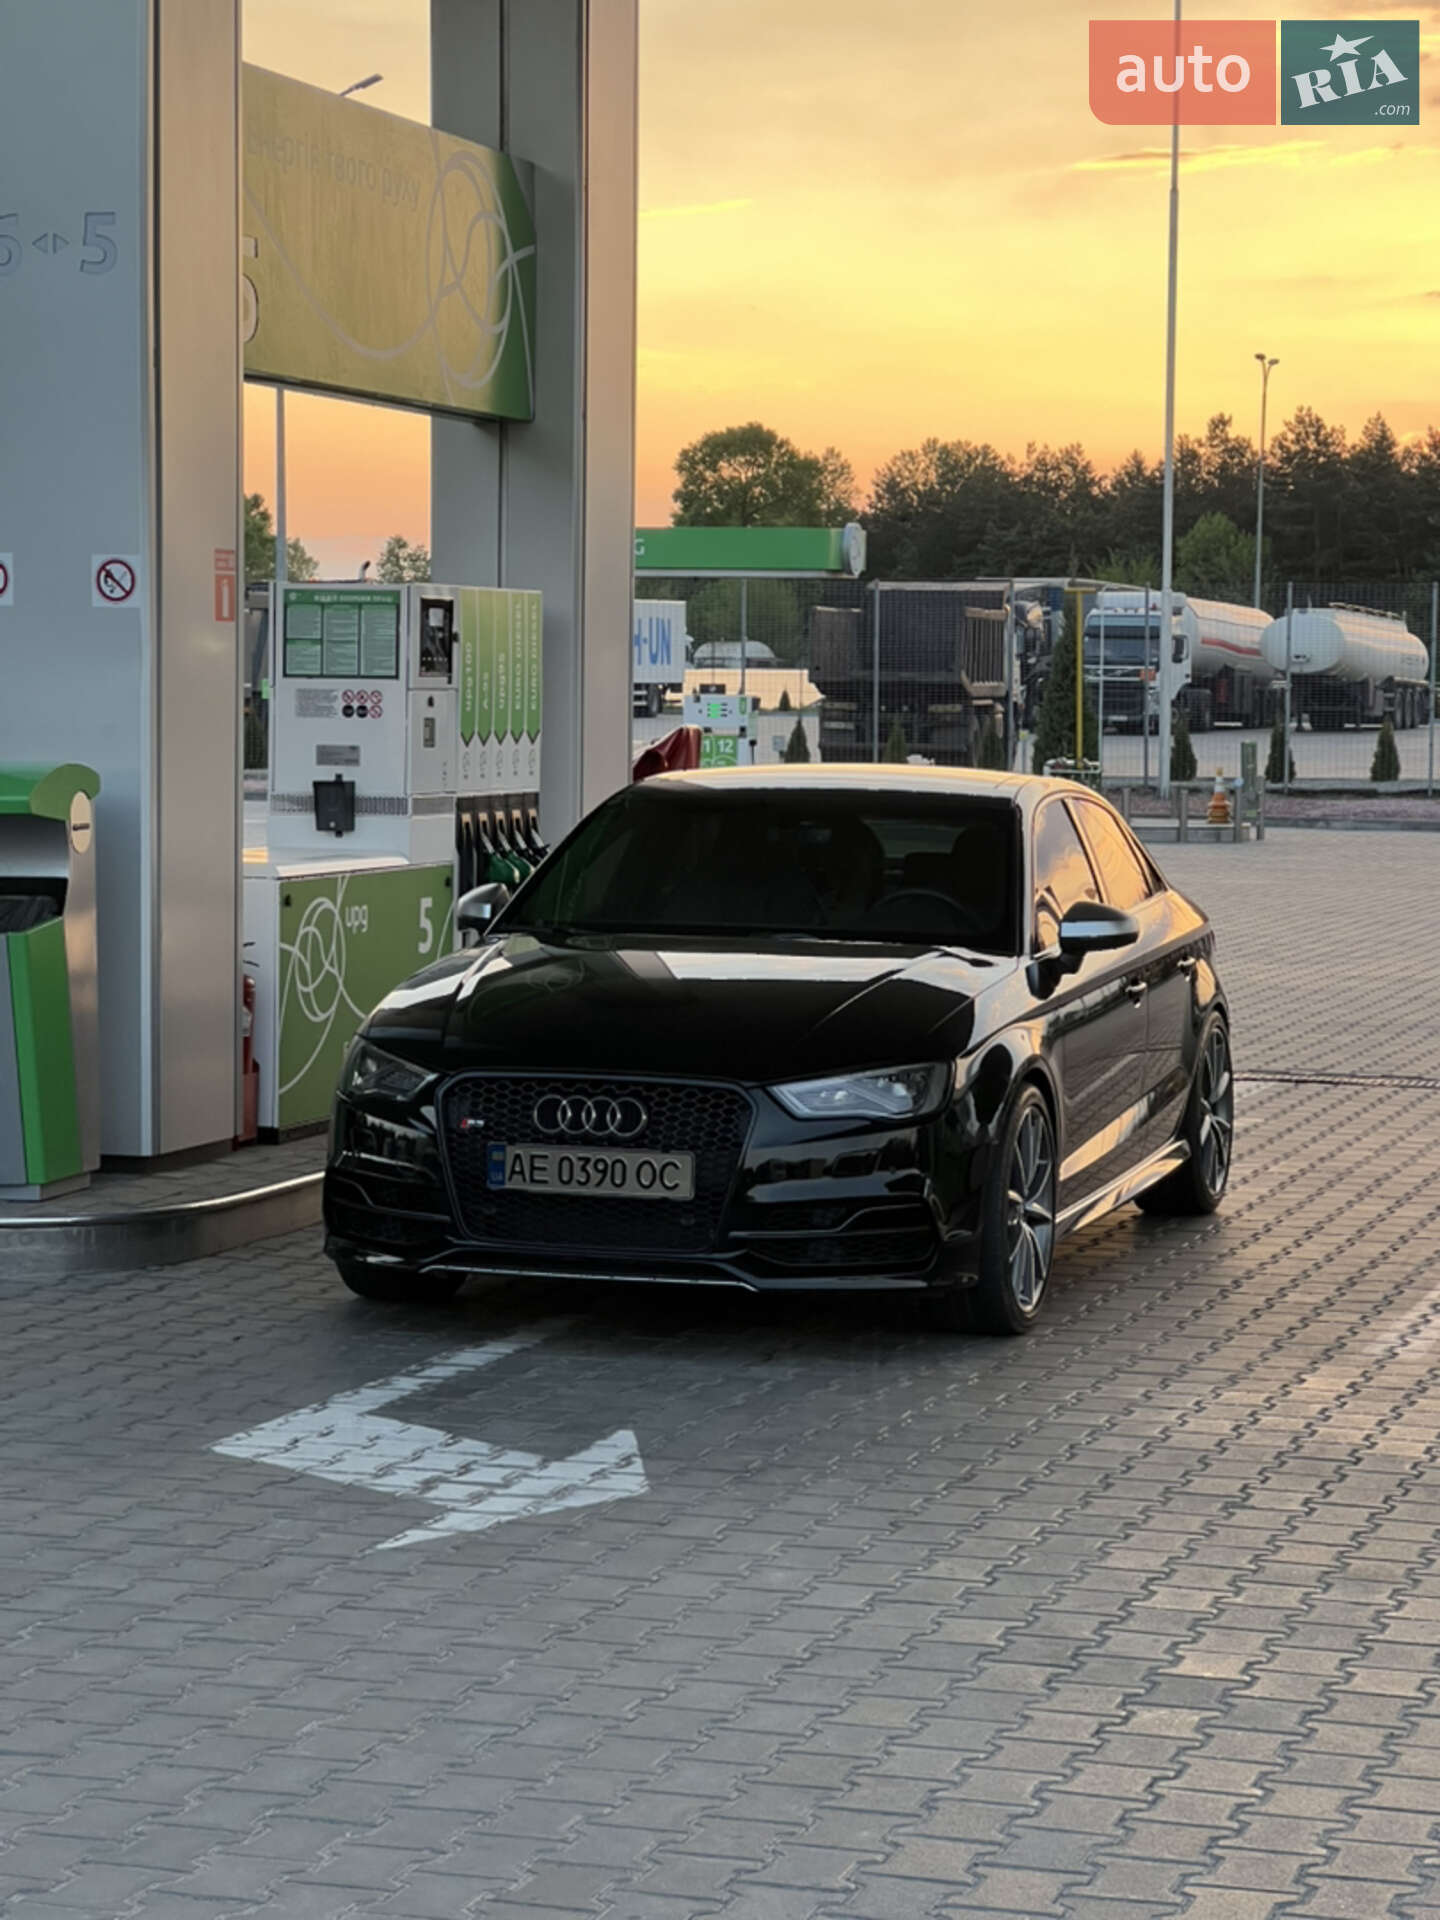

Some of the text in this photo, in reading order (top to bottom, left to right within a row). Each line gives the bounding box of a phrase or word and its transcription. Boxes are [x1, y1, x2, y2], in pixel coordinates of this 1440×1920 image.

[80, 212, 118, 275] 5
[717, 739, 733, 753] 12
[345, 897, 433, 954] upg 5
[508, 1153, 681, 1191] AE 0390 OC
